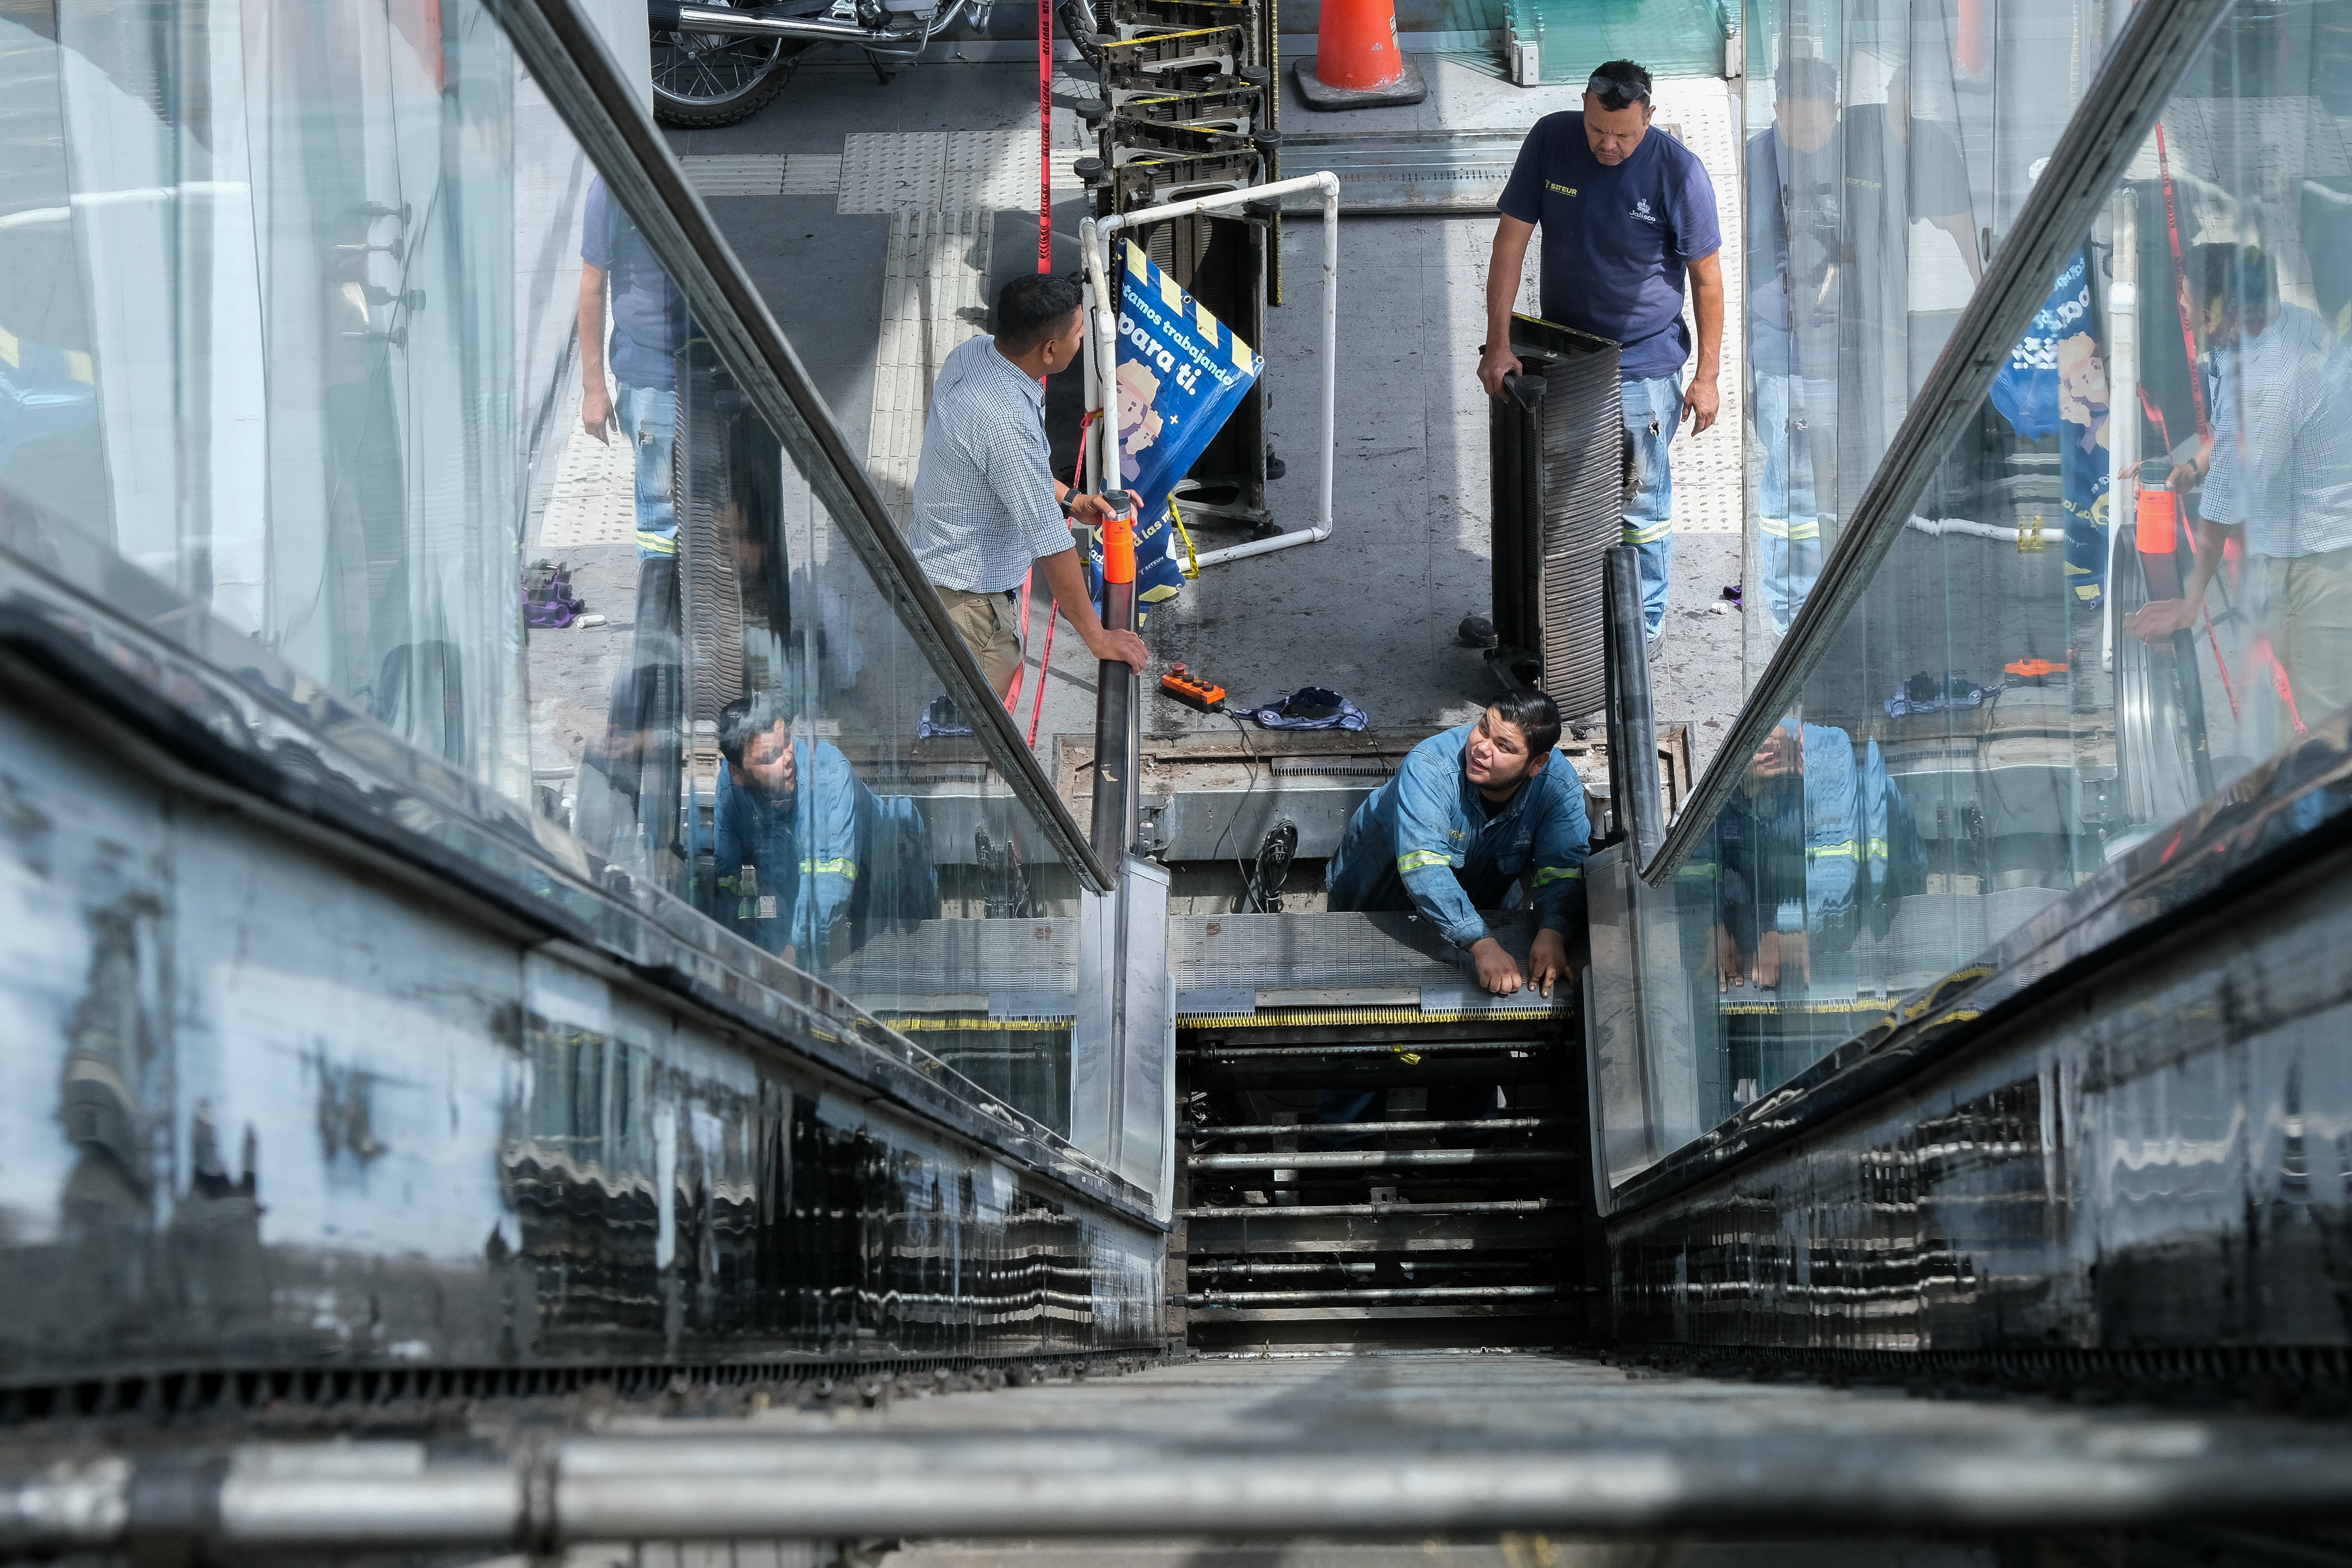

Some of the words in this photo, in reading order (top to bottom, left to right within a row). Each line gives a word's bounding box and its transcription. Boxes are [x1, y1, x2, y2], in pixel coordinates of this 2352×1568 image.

[1550, 183, 1577, 195] SITEUR
[1629, 210, 1655, 222] Jalisco
[1122, 282, 1162, 325] tamos
[1163, 320, 1233, 386] trabajando
[1118, 312, 1175, 373] para
[1176, 363, 1202, 395] ti.
[1141, 520, 1162, 539] las
[1145, 556, 1164, 570] SITEUR
